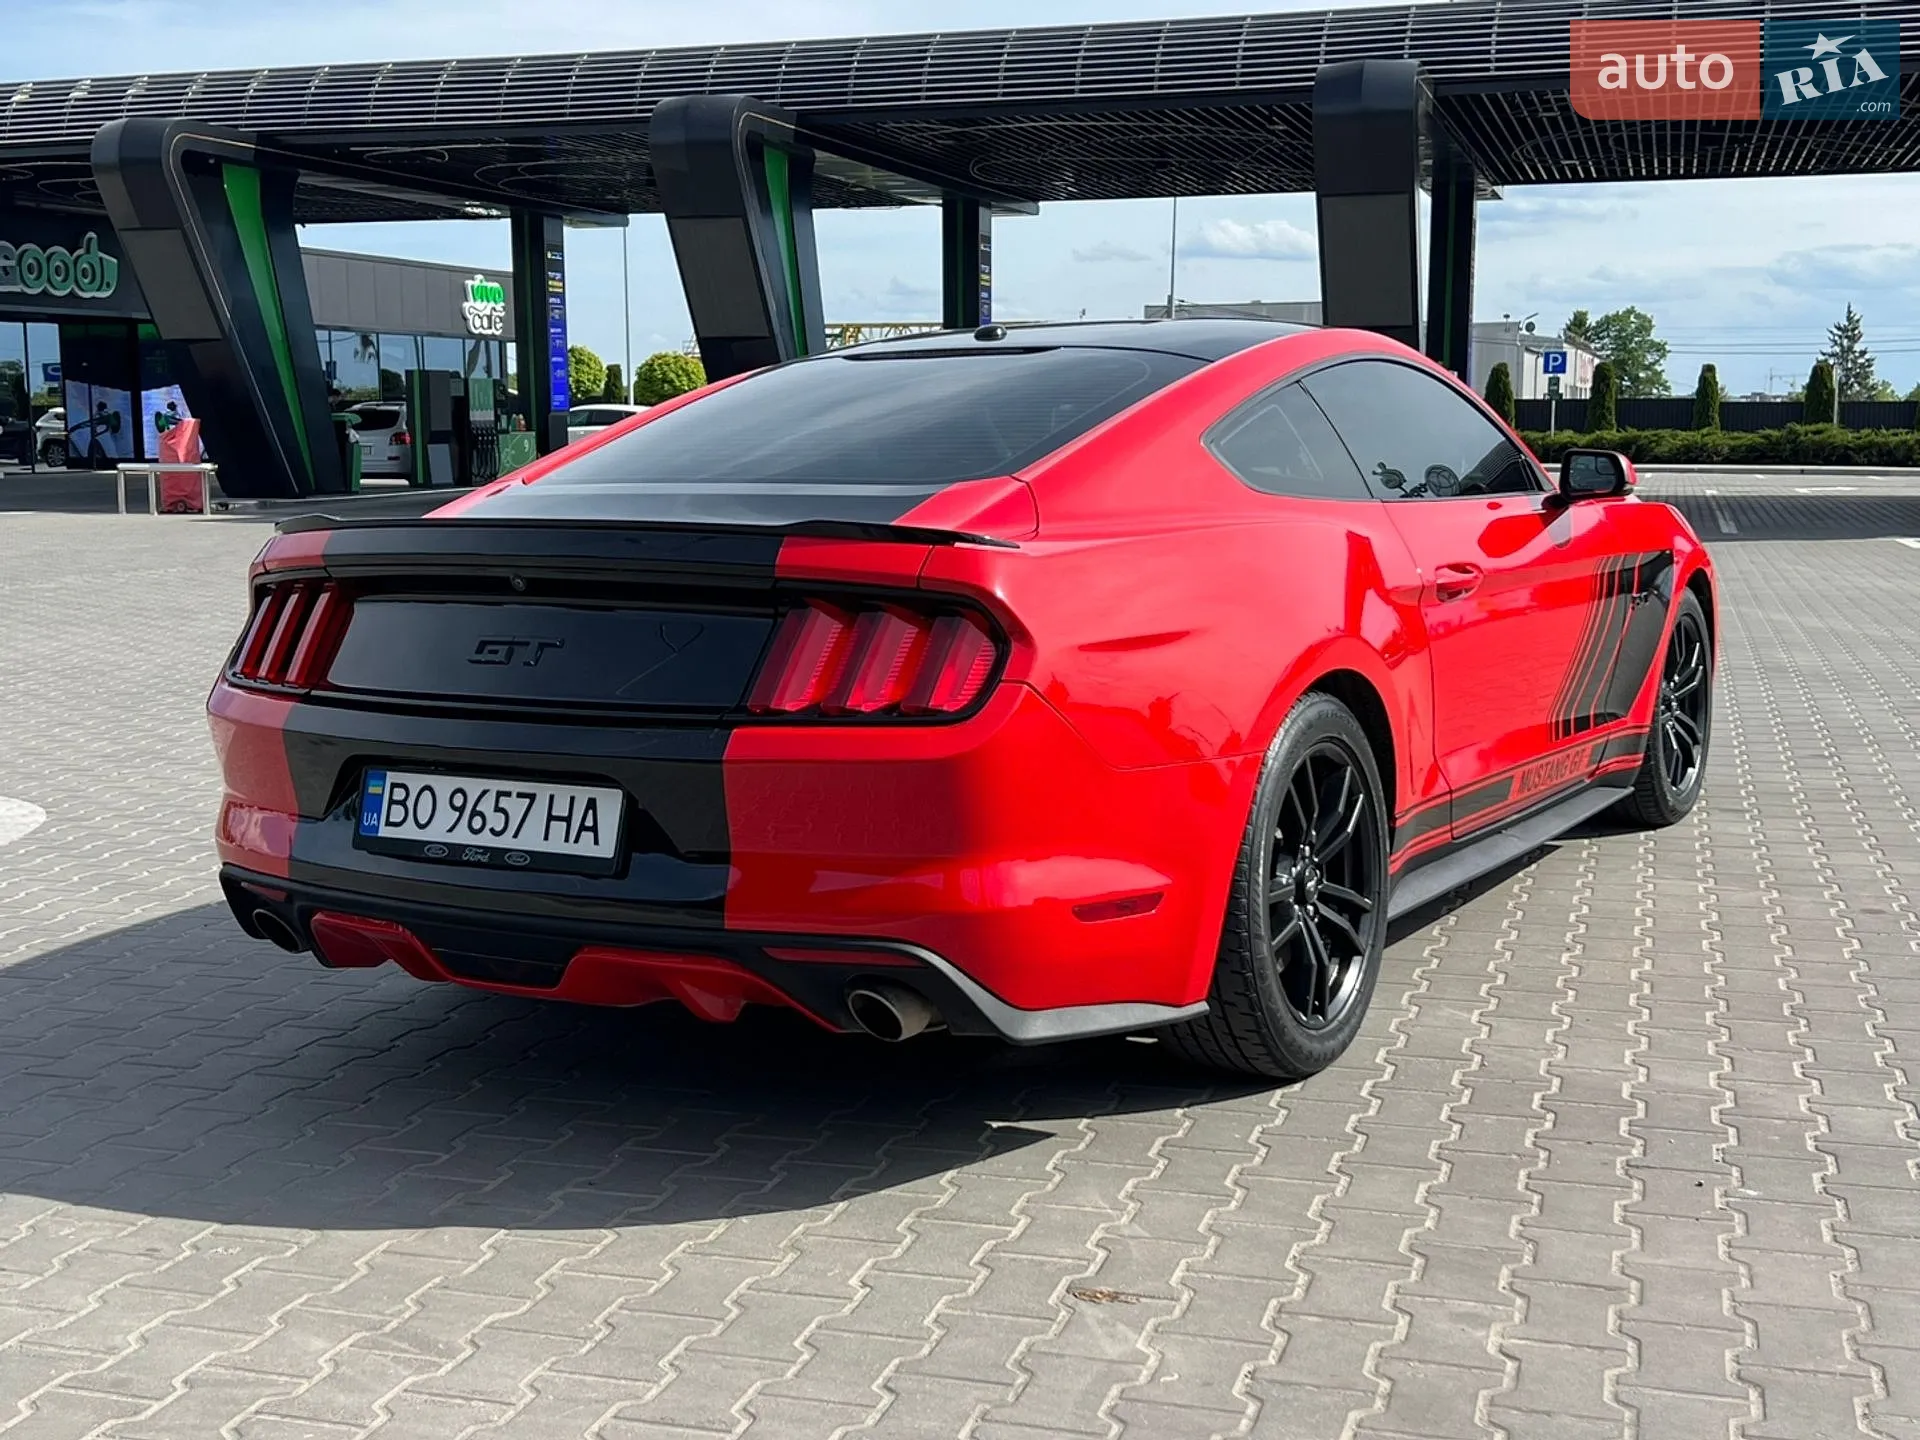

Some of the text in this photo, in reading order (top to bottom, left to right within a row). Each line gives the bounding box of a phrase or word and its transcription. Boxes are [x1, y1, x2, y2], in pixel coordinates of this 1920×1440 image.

[1549, 353, 1562, 372] P
[466, 636, 564, 668] GT
[1518, 746, 1586, 793] MUSTANG GT
[363, 812, 379, 828] UA
[384, 782, 600, 847] BO 9657 HA
[462, 846, 491, 863] Ford
